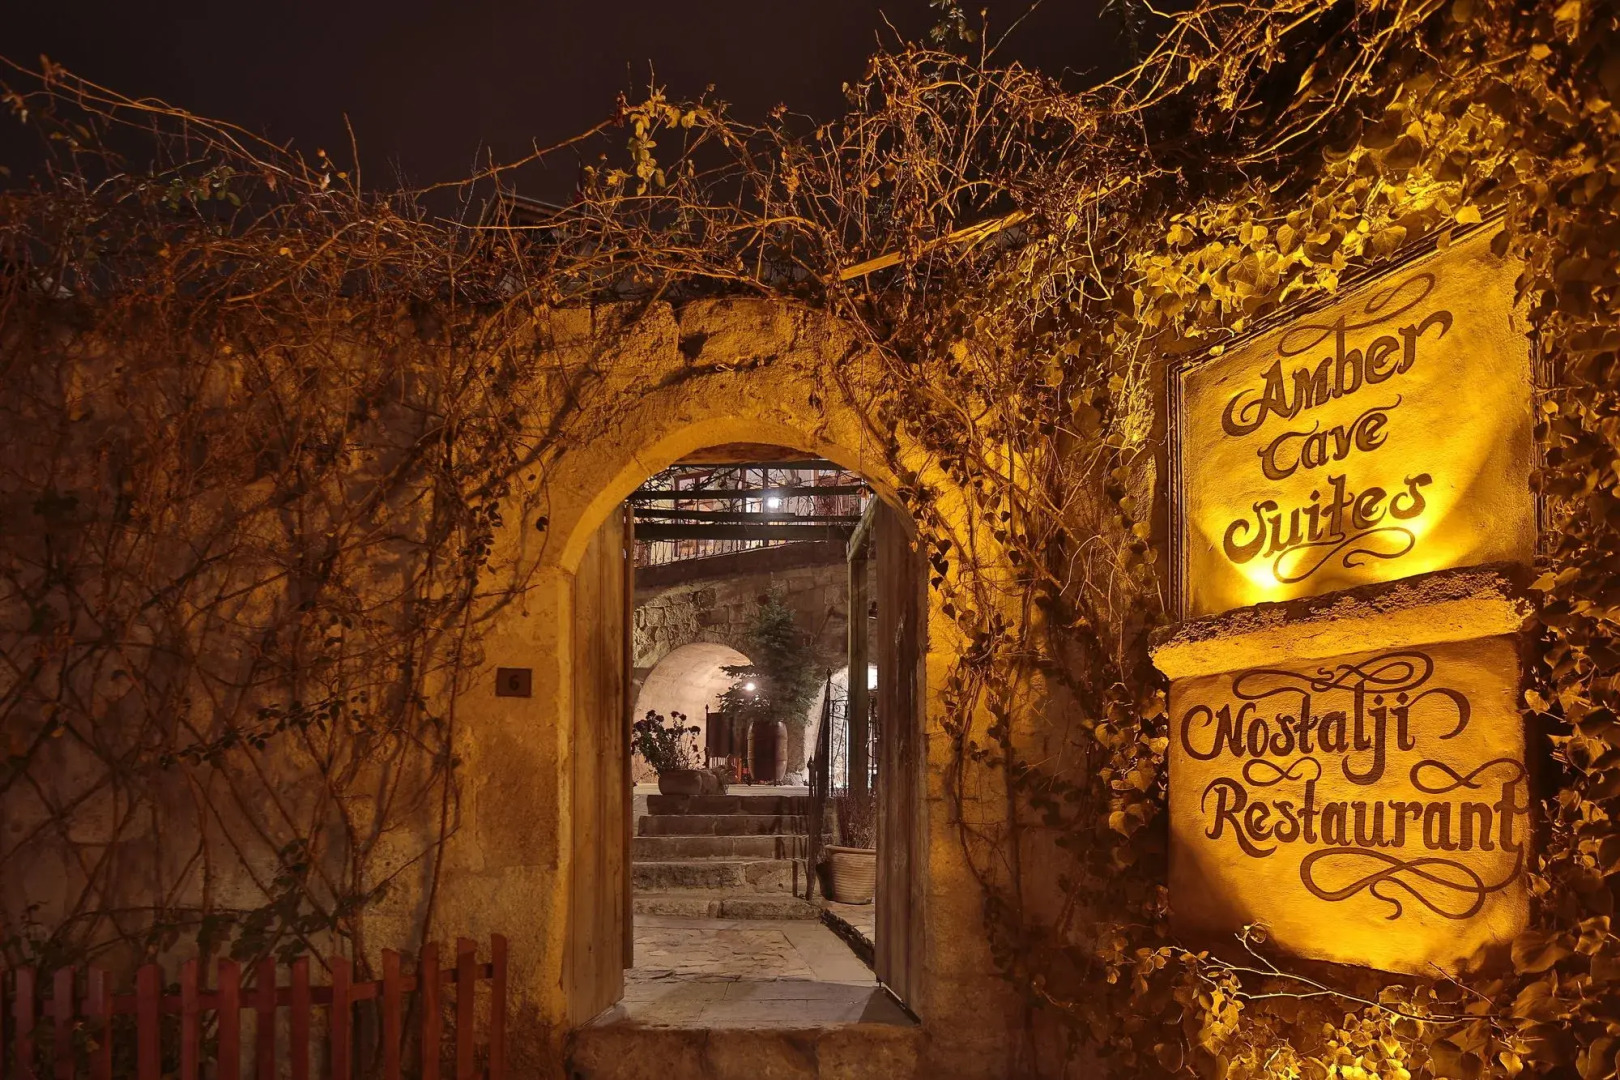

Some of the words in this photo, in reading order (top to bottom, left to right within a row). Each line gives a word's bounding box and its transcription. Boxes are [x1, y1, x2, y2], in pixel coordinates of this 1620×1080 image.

[1221, 288, 1454, 437] Amber
[1257, 394, 1403, 481] Cave
[1223, 473, 1433, 570] Suites
[508, 674, 520, 691] 6
[1180, 665, 1471, 786] Nostalji
[1201, 757, 1530, 858] Restaurant
